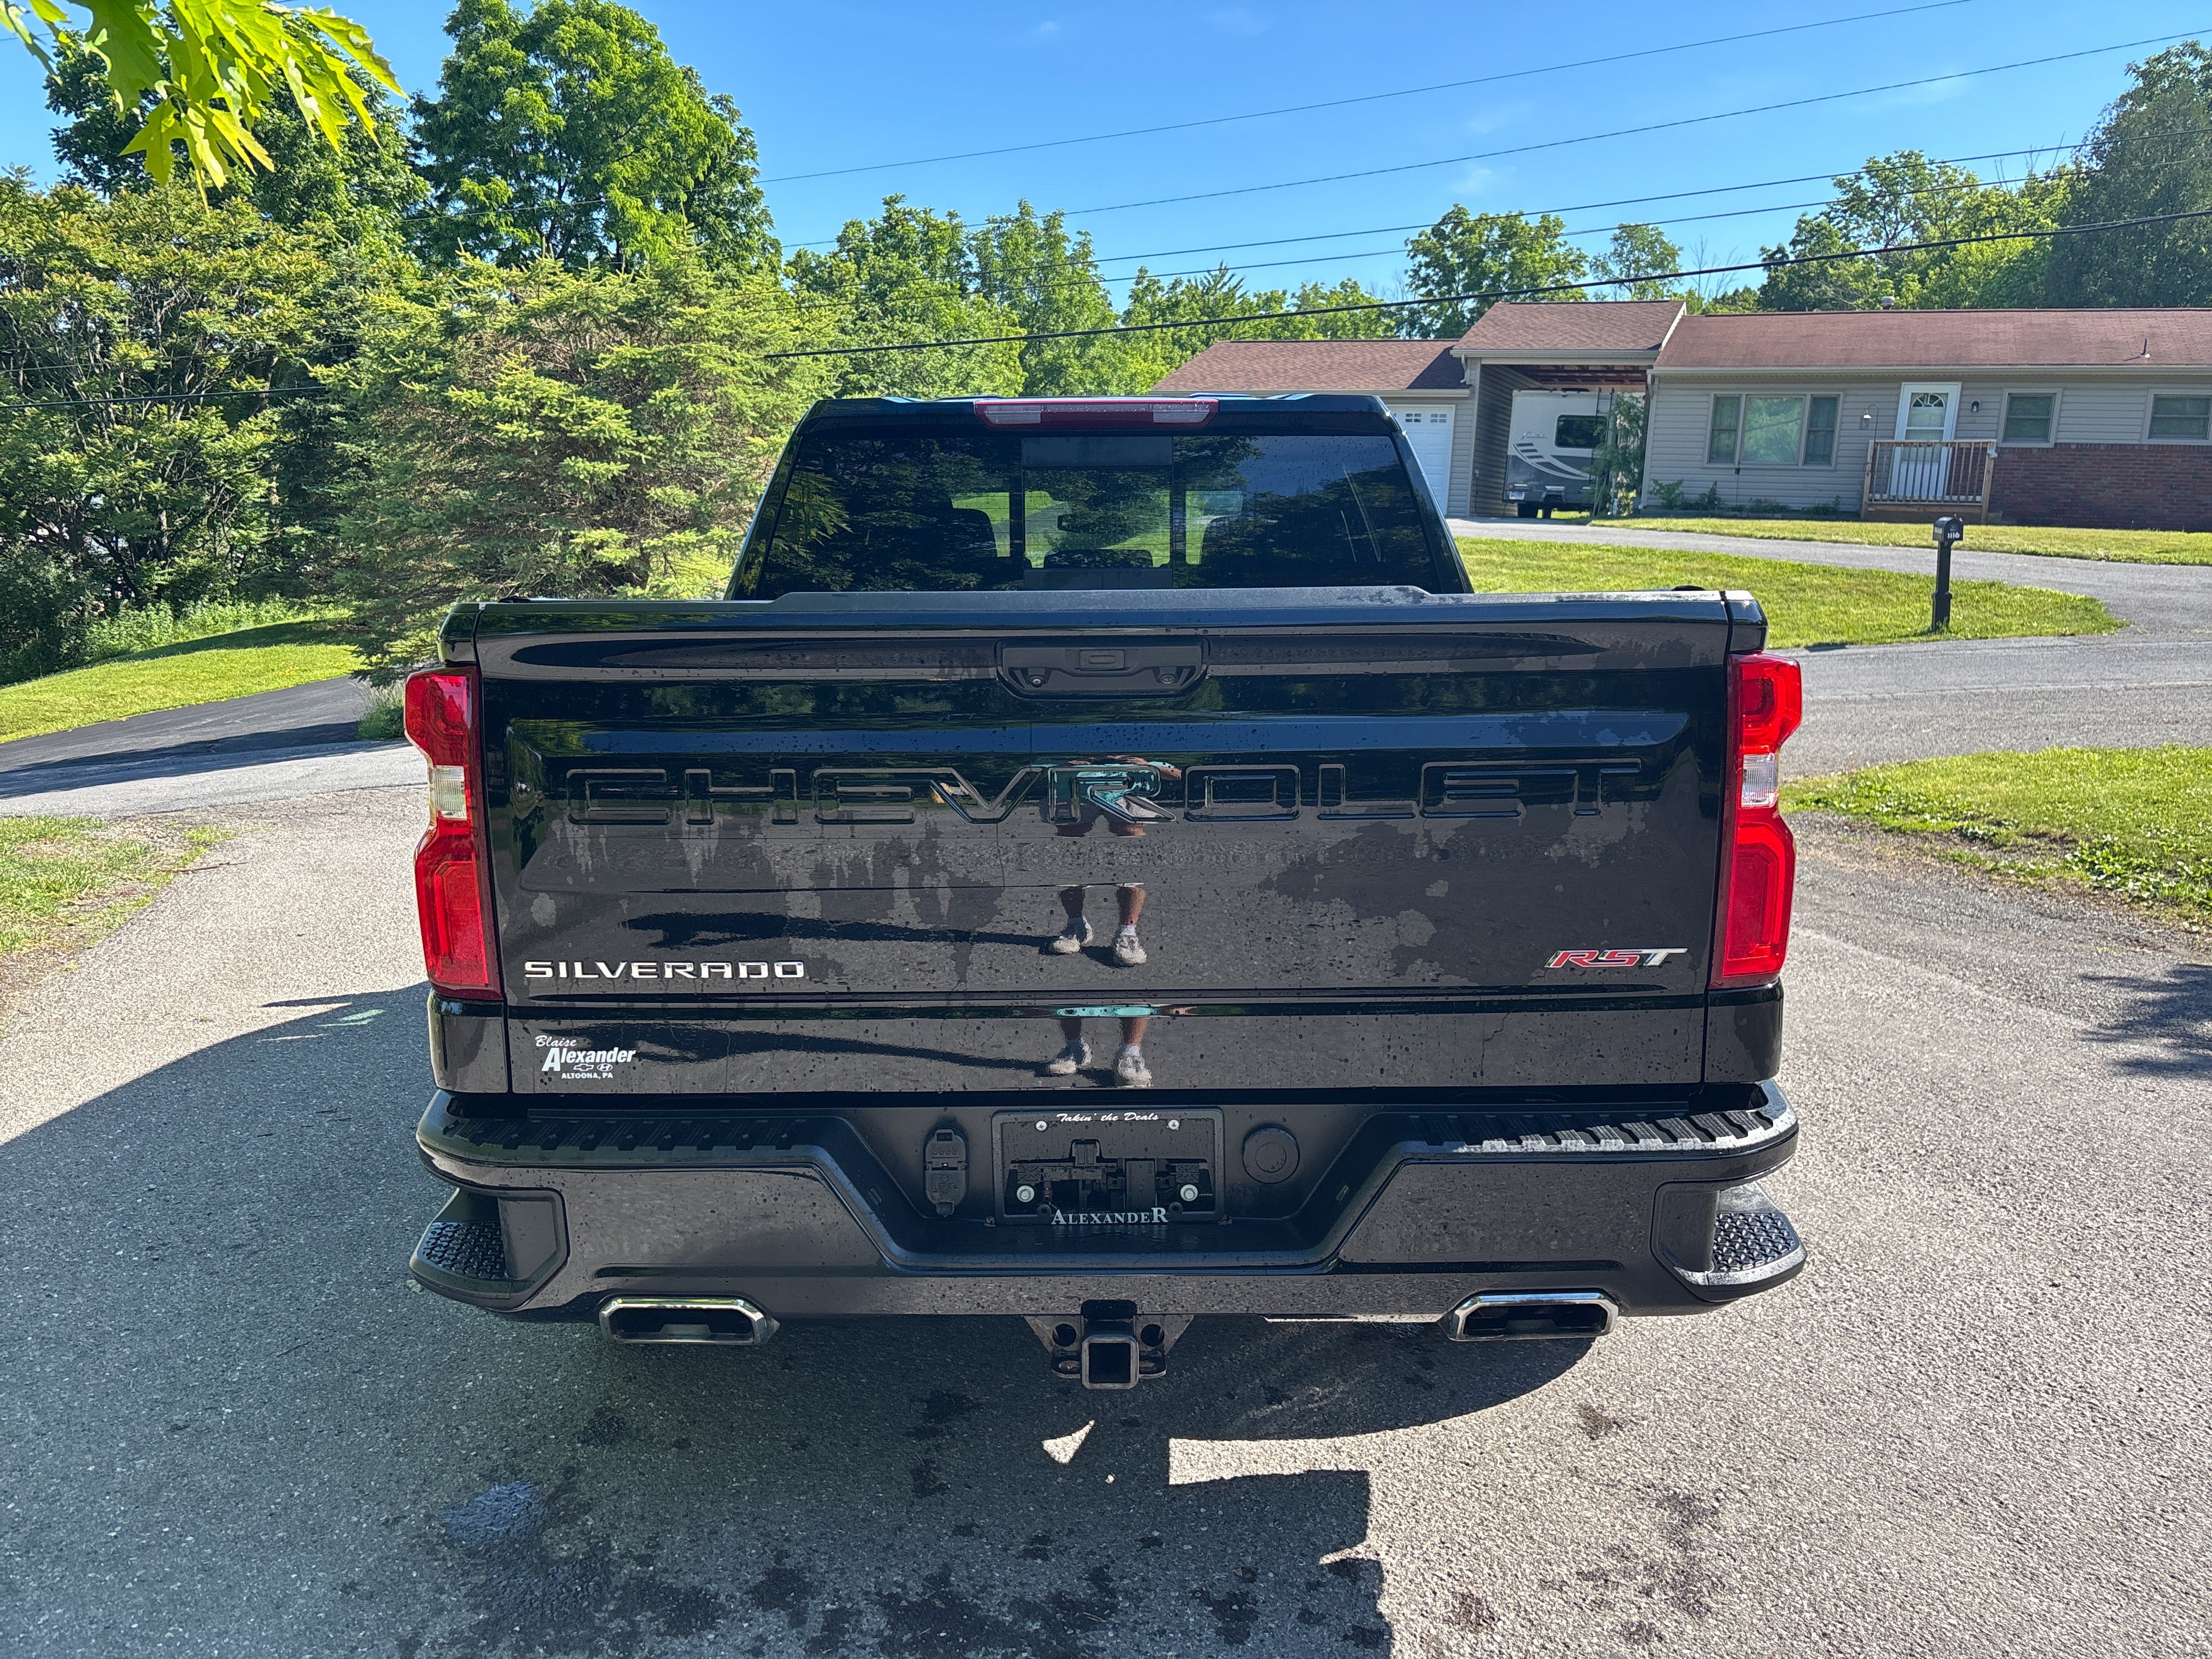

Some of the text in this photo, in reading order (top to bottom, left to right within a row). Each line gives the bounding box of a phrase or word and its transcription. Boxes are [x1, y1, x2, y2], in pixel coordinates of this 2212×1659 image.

[566, 757, 1643, 826] CHEVROLET
[1543, 947, 1688, 968] RST
[524, 961, 805, 979] SILVERADO
[534, 1035, 578, 1047] Blaise
[540, 1047, 636, 1071] Alexander
[1056, 1112, 1159, 1122] Takin' the Deals
[1051, 1207, 1169, 1225] ALEXANDER
